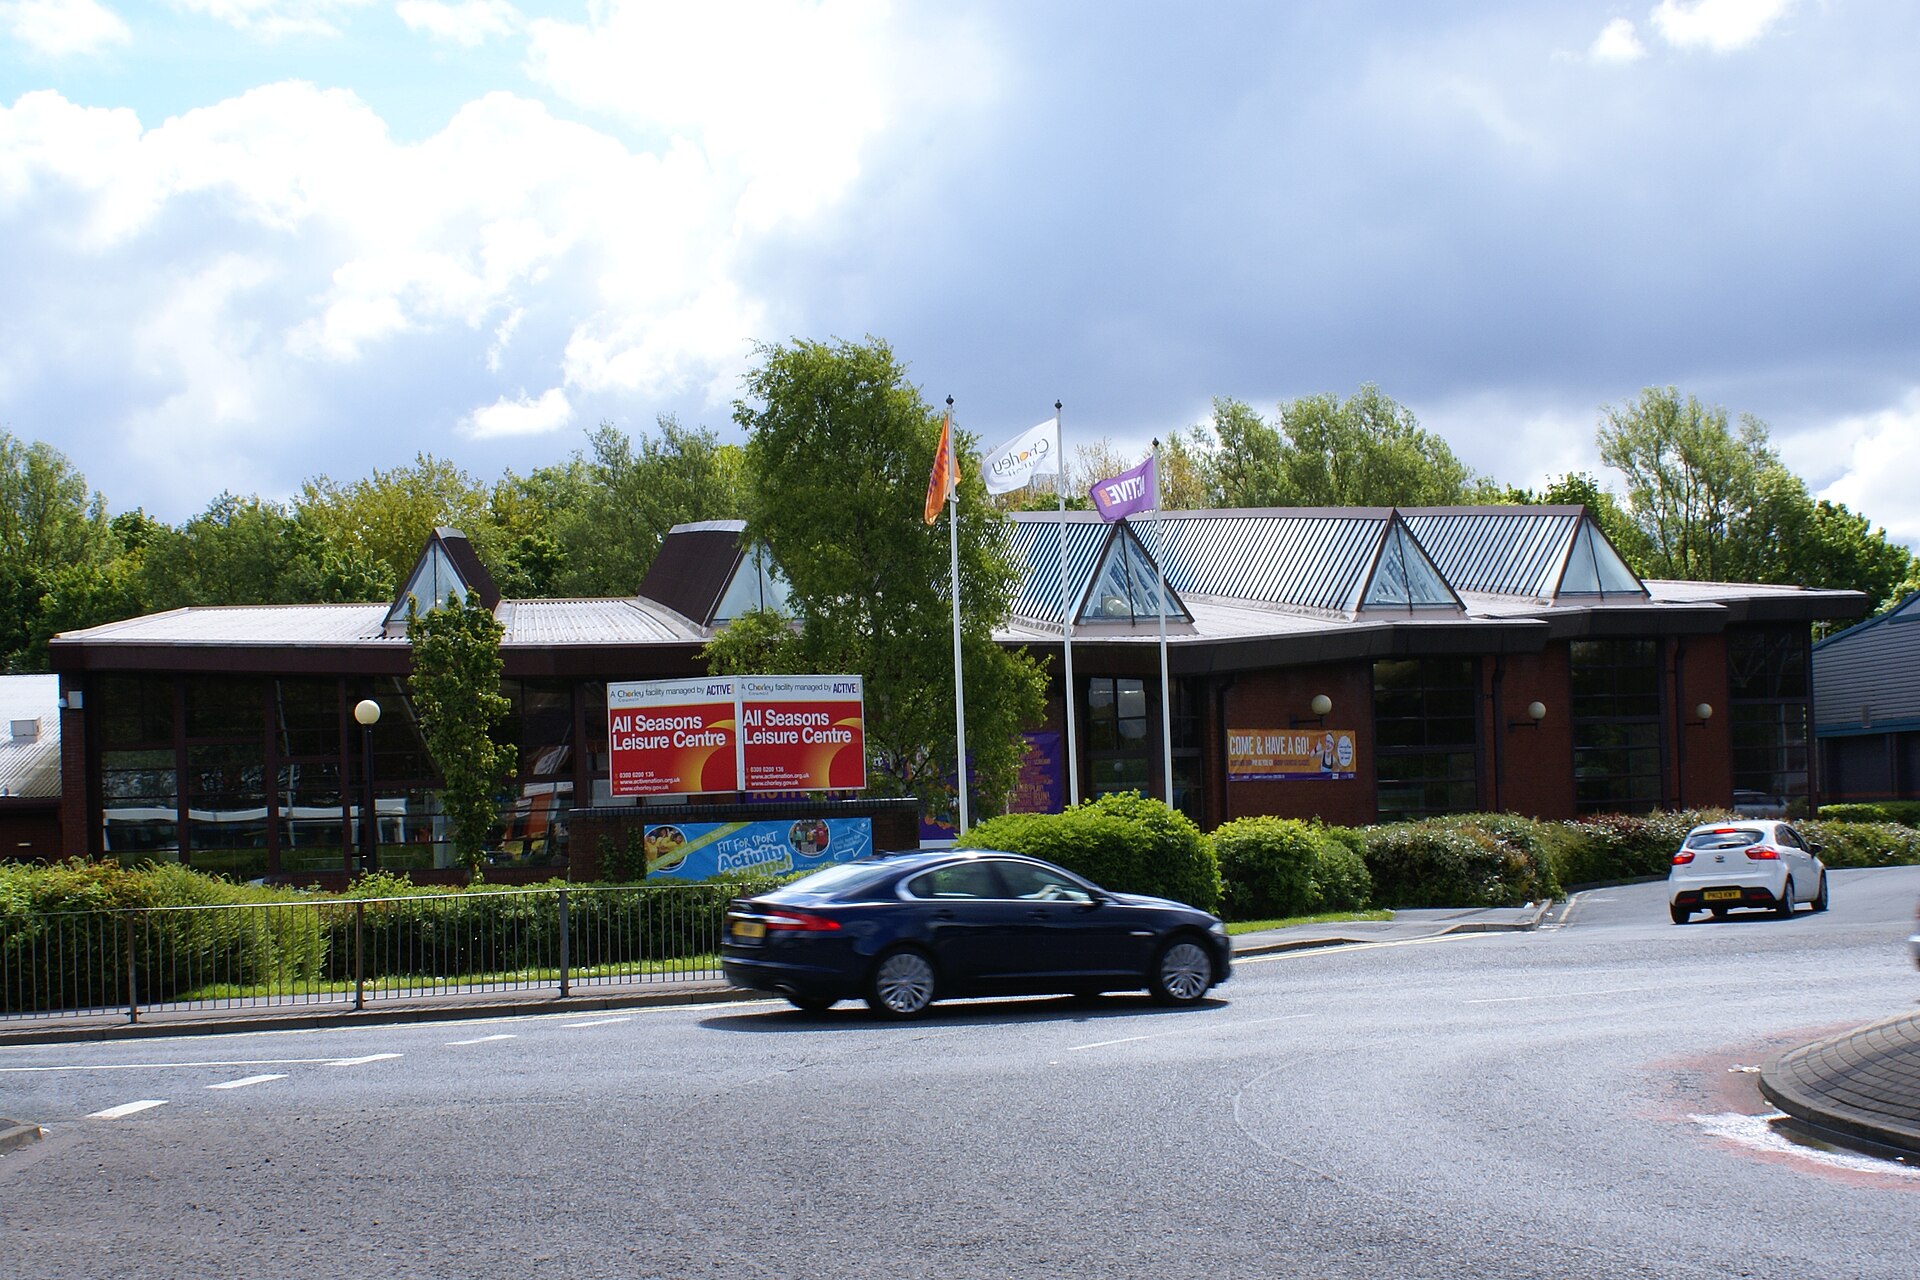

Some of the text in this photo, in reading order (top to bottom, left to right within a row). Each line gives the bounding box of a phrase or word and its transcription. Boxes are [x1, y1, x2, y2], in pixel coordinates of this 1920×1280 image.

[618, 690, 644, 698] Chorley
[646, 688, 665, 697] facility
[666, 686, 696, 696] managed
[697, 685, 705, 694] by
[748, 683, 774, 692] Chorley
[775, 683, 794, 692] facility
[795, 683, 823, 692] managed
[824, 683, 832, 692] by
[612, 714, 702, 733] All Seasons
[743, 709, 829, 726] All Seasons
[613, 730, 726, 751] Leisure Centre
[744, 726, 852, 745] Leisure Centre
[1229, 736, 1310, 755] COME & HAVE A GO!
[717, 830, 778, 854] FIT FOR SPORT
[719, 844, 787, 872] Activity
